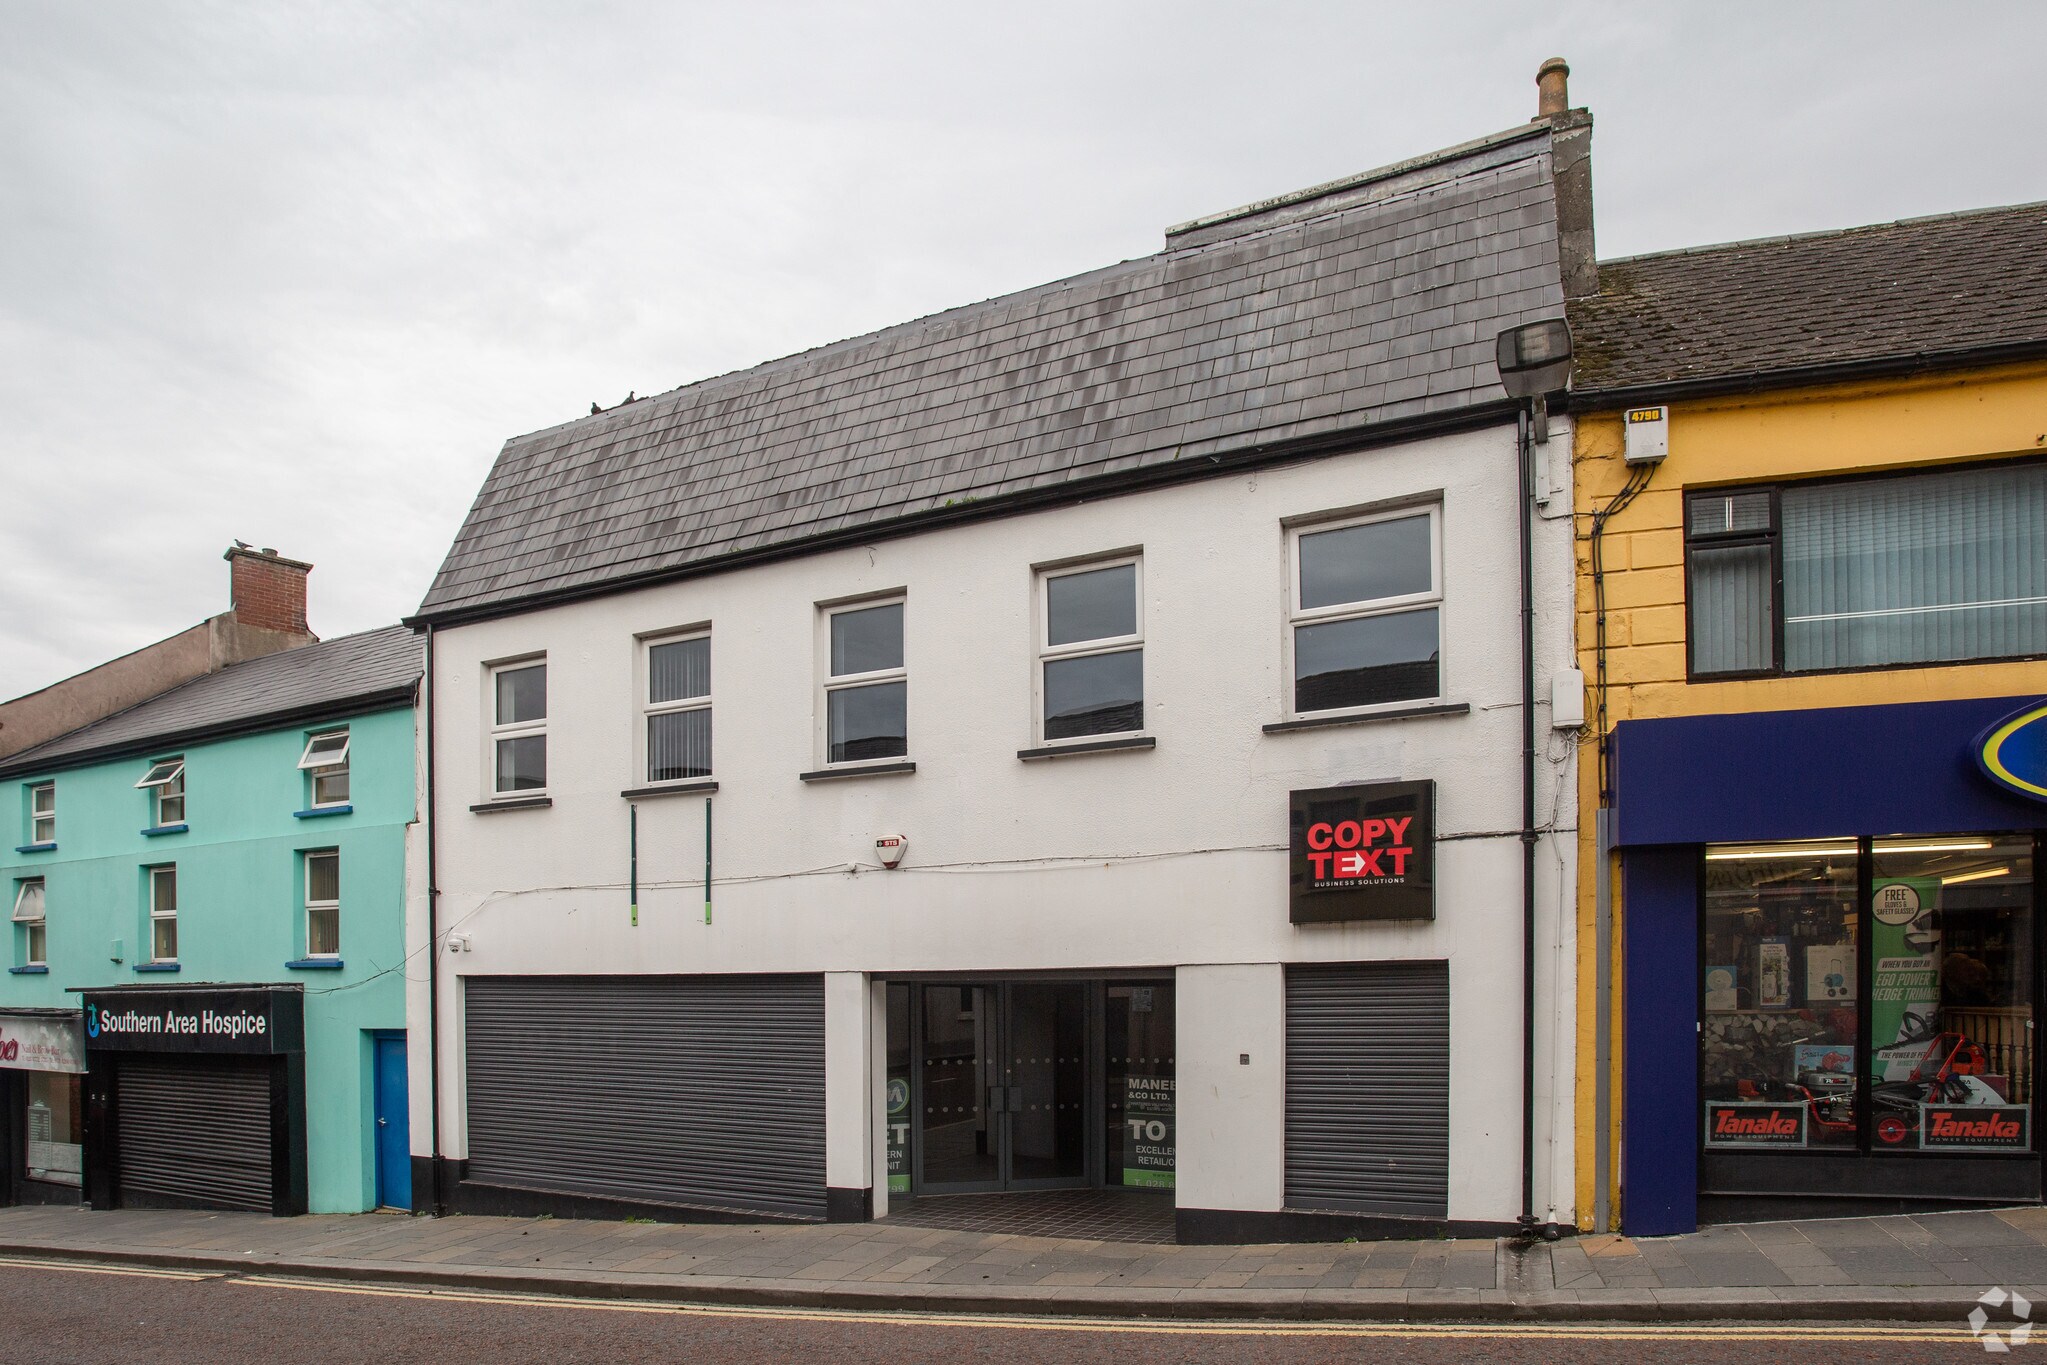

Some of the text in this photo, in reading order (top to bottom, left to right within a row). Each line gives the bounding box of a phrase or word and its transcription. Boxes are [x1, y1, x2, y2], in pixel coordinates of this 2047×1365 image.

[1631, 409, 1660, 421] 4790
[1307, 817, 1412, 850] COPY
[1307, 847, 1412, 879] TEXT
[1358, 877, 1405, 885] SOLUTIONS
[1882, 960, 1900, 969] WHEN
[1901, 960, 1912, 968] YOU
[1913, 960, 1923, 968] BUY
[1876, 974, 1896, 986] EGO
[1872, 988, 1904, 1001] HEDGE
[101, 1009, 266, 1039] Southern Area Hospice
[1882, 1051, 1892, 1059] THE
[1892, 1051, 1909, 1059] POWER
[1910, 1051, 1917, 1059] OF
[1128, 1091, 1170, 1100] &CO LTD.
[1715, 1109, 1797, 1134] Tanaka
[1930, 1112, 2020, 1137] Tanaka
[1128, 1119, 1166, 1141] TO
